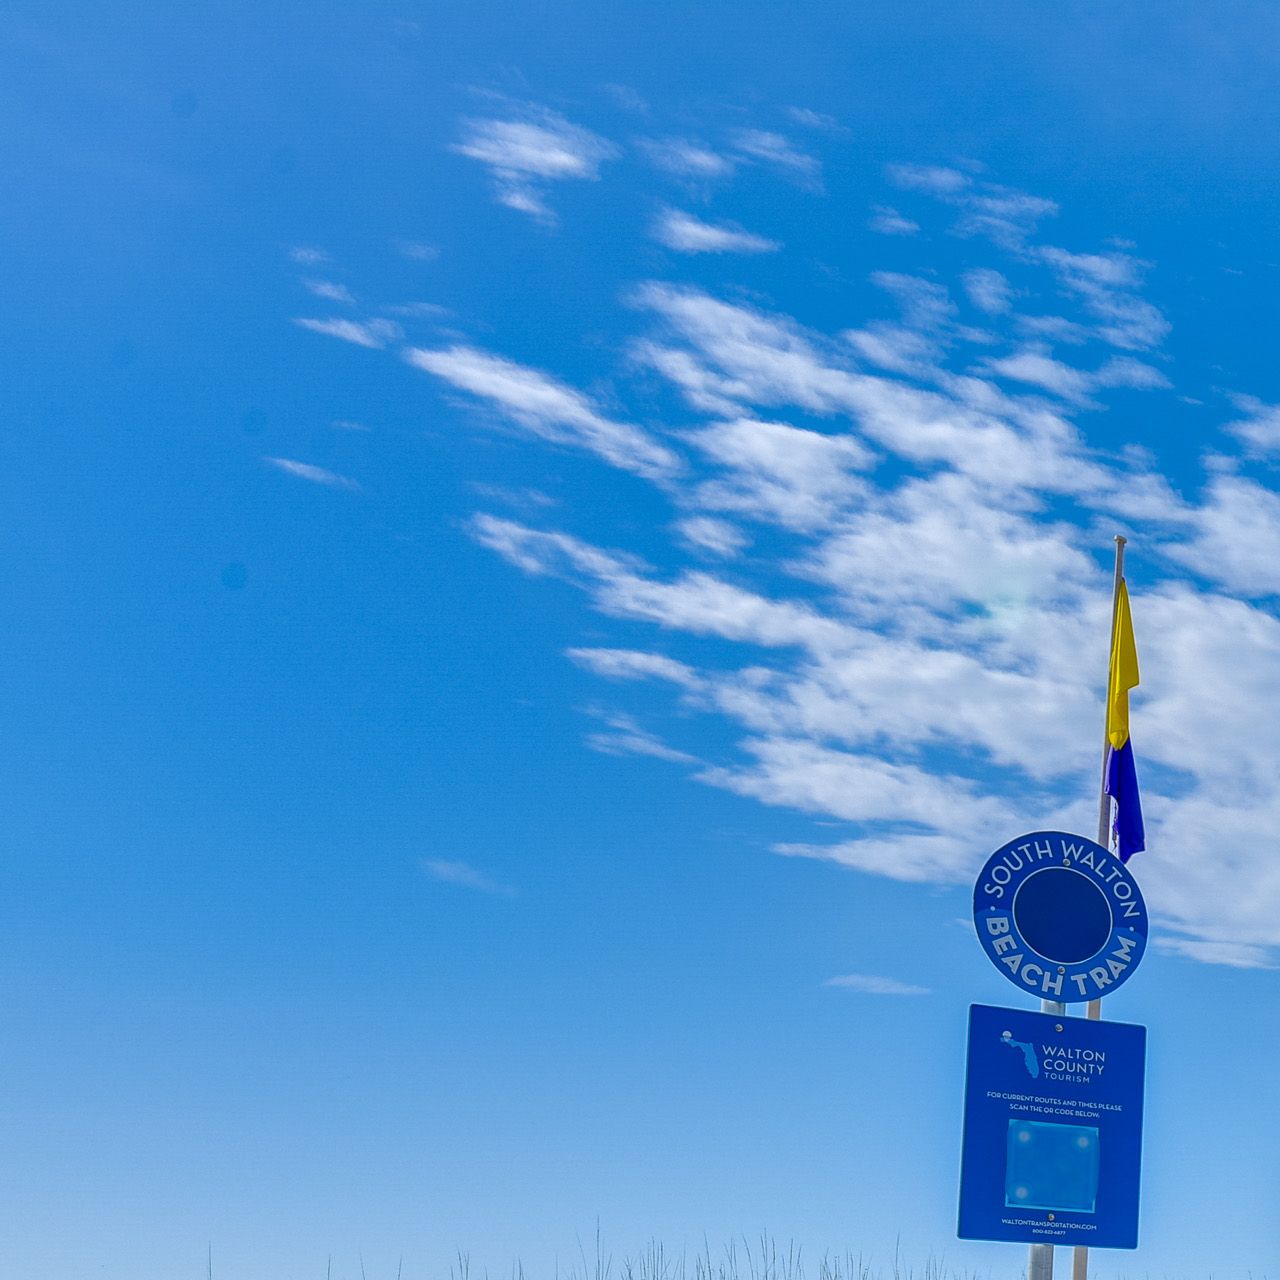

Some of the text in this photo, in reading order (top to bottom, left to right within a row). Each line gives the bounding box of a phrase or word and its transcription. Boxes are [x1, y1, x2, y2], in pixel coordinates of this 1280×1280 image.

[985, 840, 1140, 918] SOUTH WALTON
[986, 917, 1137, 996] BEACH TRAM
[1042, 1044, 1105, 1062] WALTON
[1043, 1059, 1104, 1075] COUNTY
[1044, 1072, 1090, 1083] TOURISM
[1002, 1093, 1034, 1102] CURRENT
[1035, 1096, 1061, 1105] ROUTES
[1063, 1099, 1077, 1107] AND
[1078, 1101, 1097, 1109] TIMES
[1098, 1103, 1122, 1111] PLEASE
[1009, 1103, 1029, 1111] SCAN
[1055, 1108, 1074, 1116] CODE
